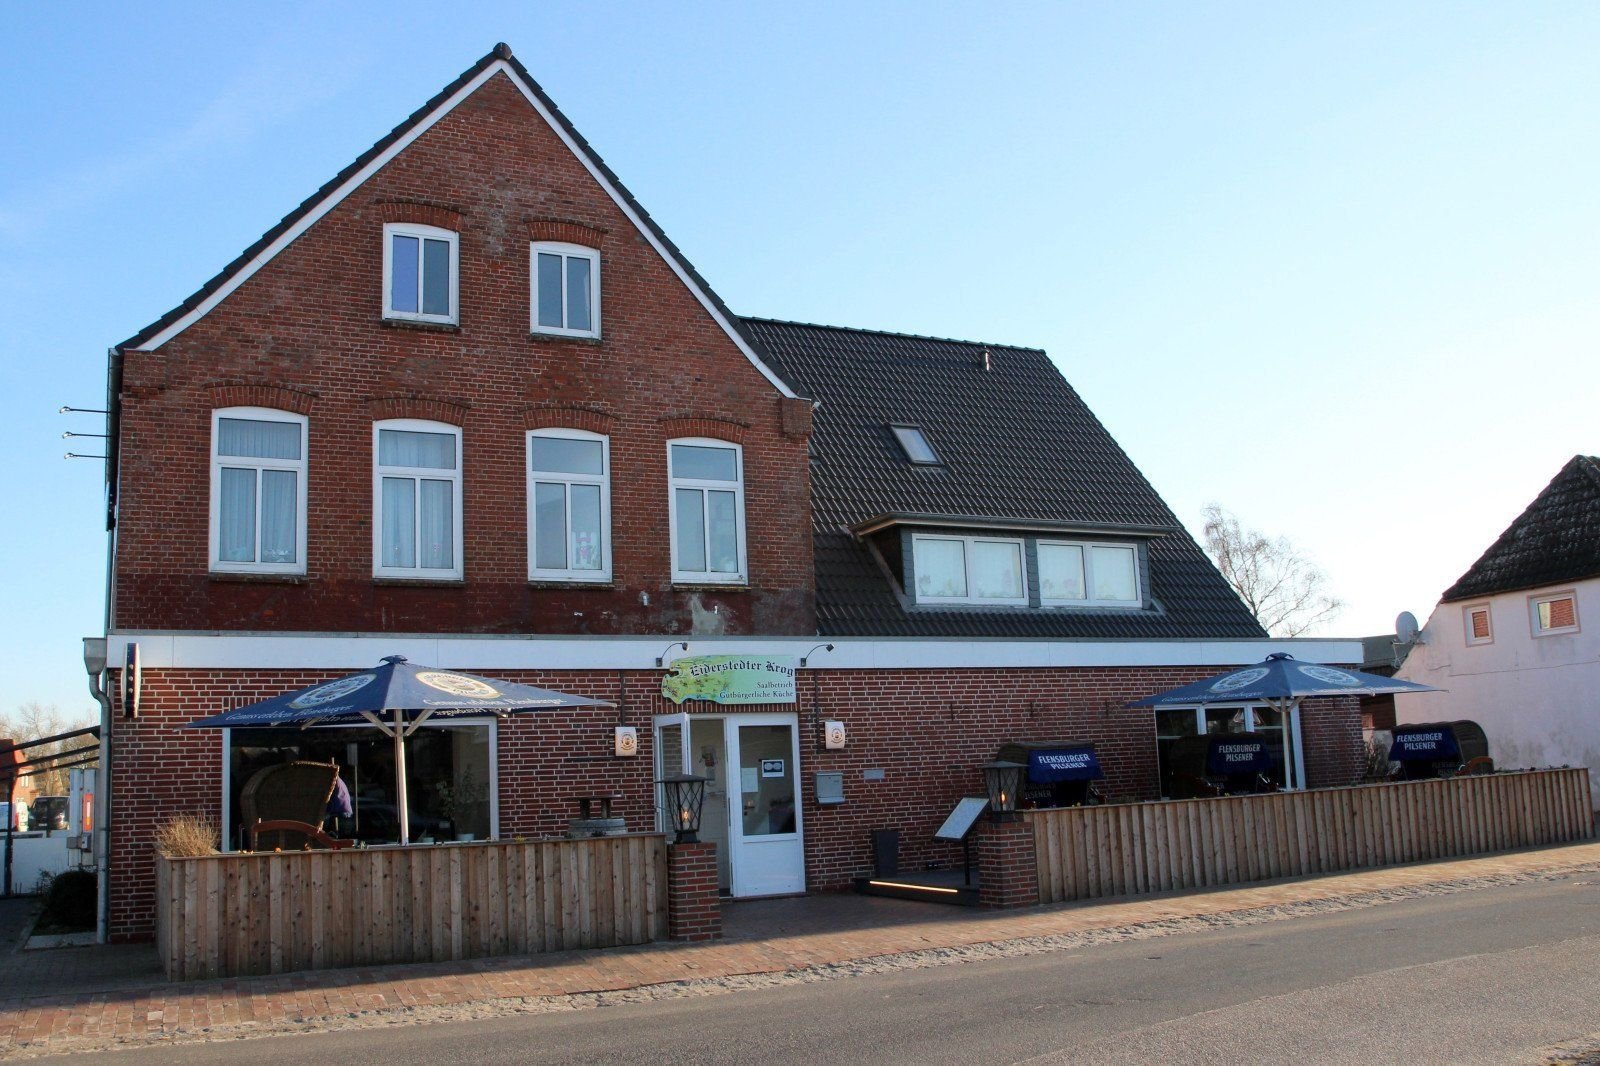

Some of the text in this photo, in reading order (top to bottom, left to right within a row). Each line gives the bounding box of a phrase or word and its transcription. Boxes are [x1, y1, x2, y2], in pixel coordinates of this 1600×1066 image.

[690, 660, 794, 677] Eiderstedter Krog
[757, 681, 793, 689] Saalbetrieb
[773, 690, 793, 698] Küche
[1397, 732, 1443, 742] FLENSBURGER
[1218, 744, 1261, 753] FLENSBURGER
[1404, 742, 1436, 750] PILSENER
[1038, 753, 1090, 764] FLENSBURGER
[1226, 753, 1254, 762] PILSENER
[1050, 762, 1087, 770] PILSENER
